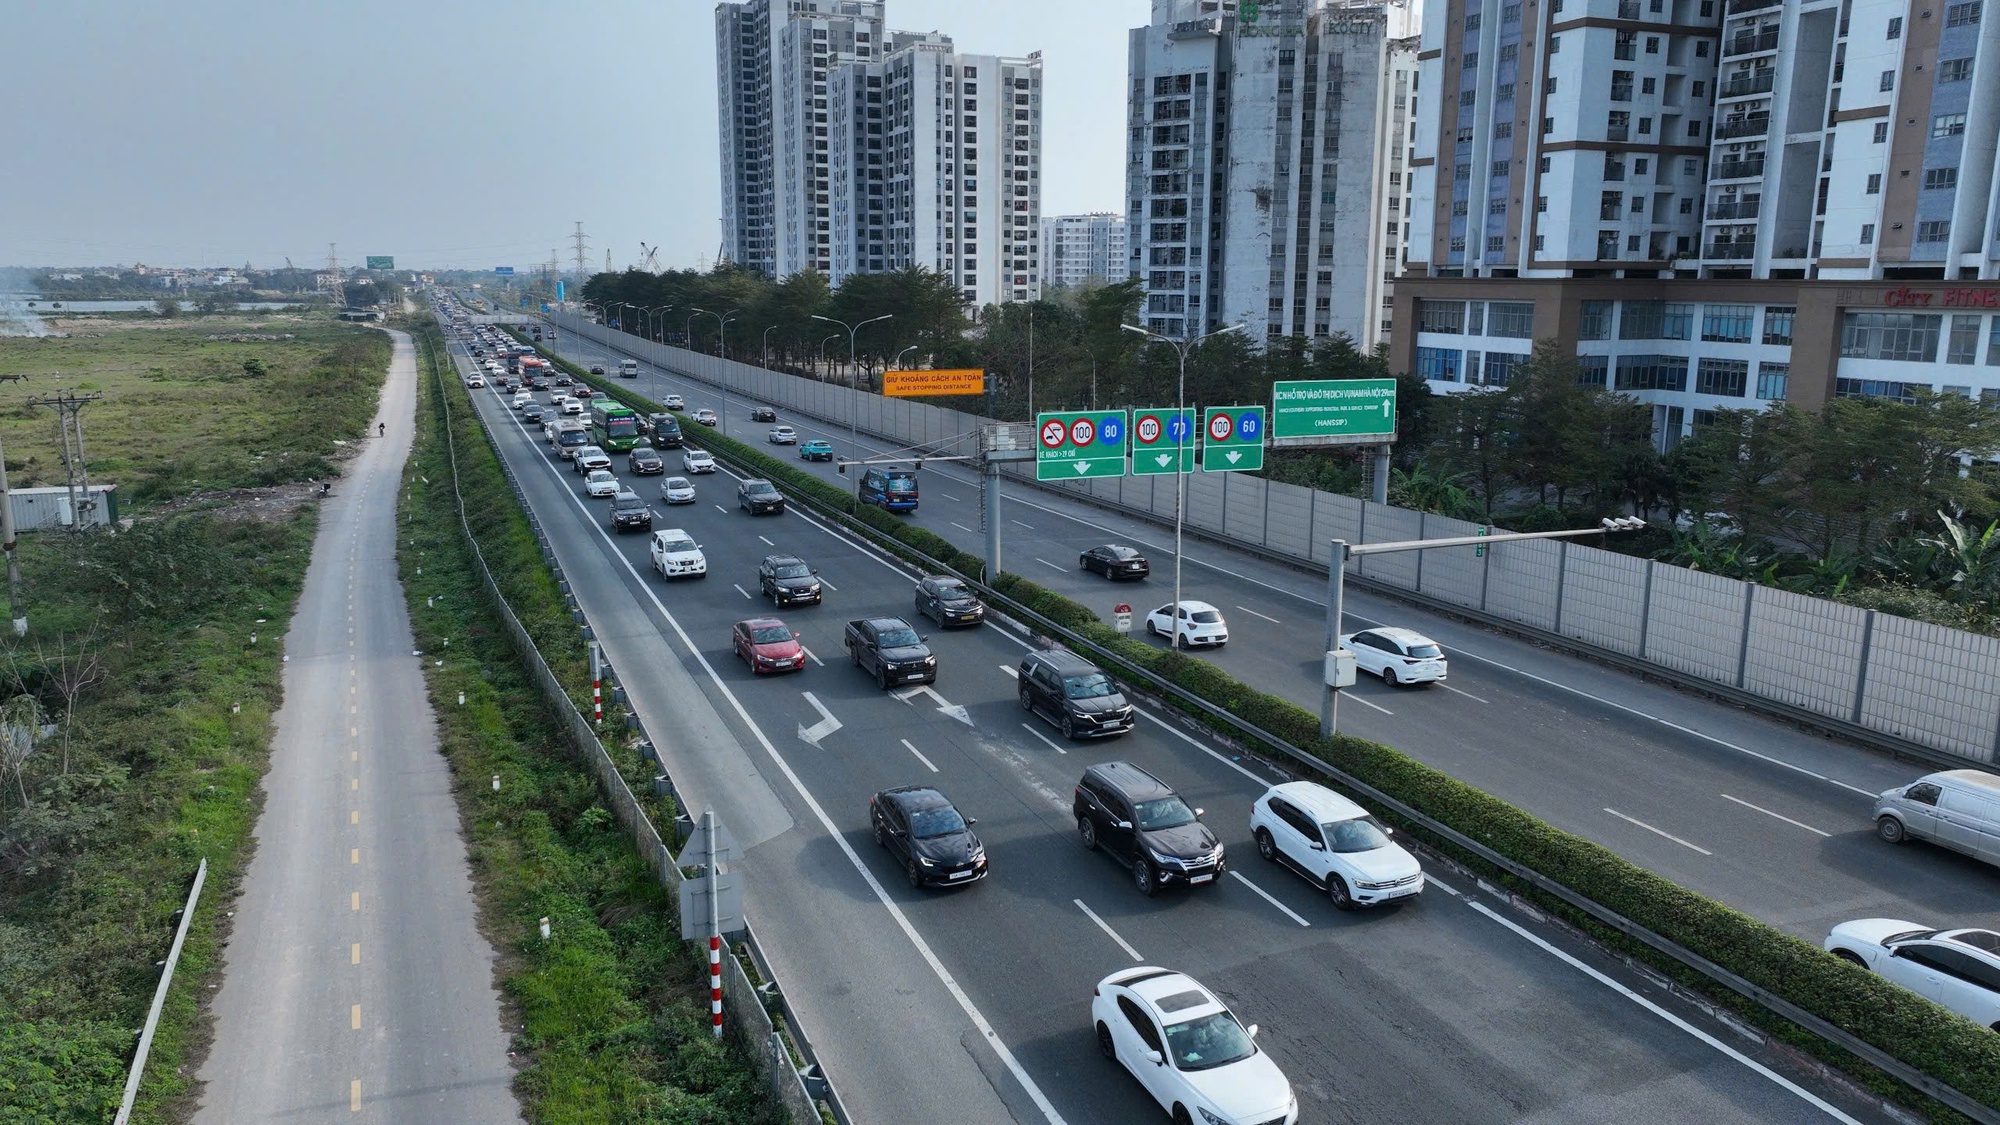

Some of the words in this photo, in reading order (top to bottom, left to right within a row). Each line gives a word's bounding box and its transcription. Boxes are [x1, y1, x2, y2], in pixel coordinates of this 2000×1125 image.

[1944, 288, 2000, 307] FITNE
[900, 372, 929, 383] KHOẢNG
[931, 373, 949, 382] CÁCH
[964, 373, 982, 381] TOÀN
[1075, 426, 1091, 439] 100
[1104, 424, 1117, 438] 80
[1142, 423, 1157, 436] 100
[1214, 421, 1228, 433] 100
[1242, 420, 1255, 433] 60
